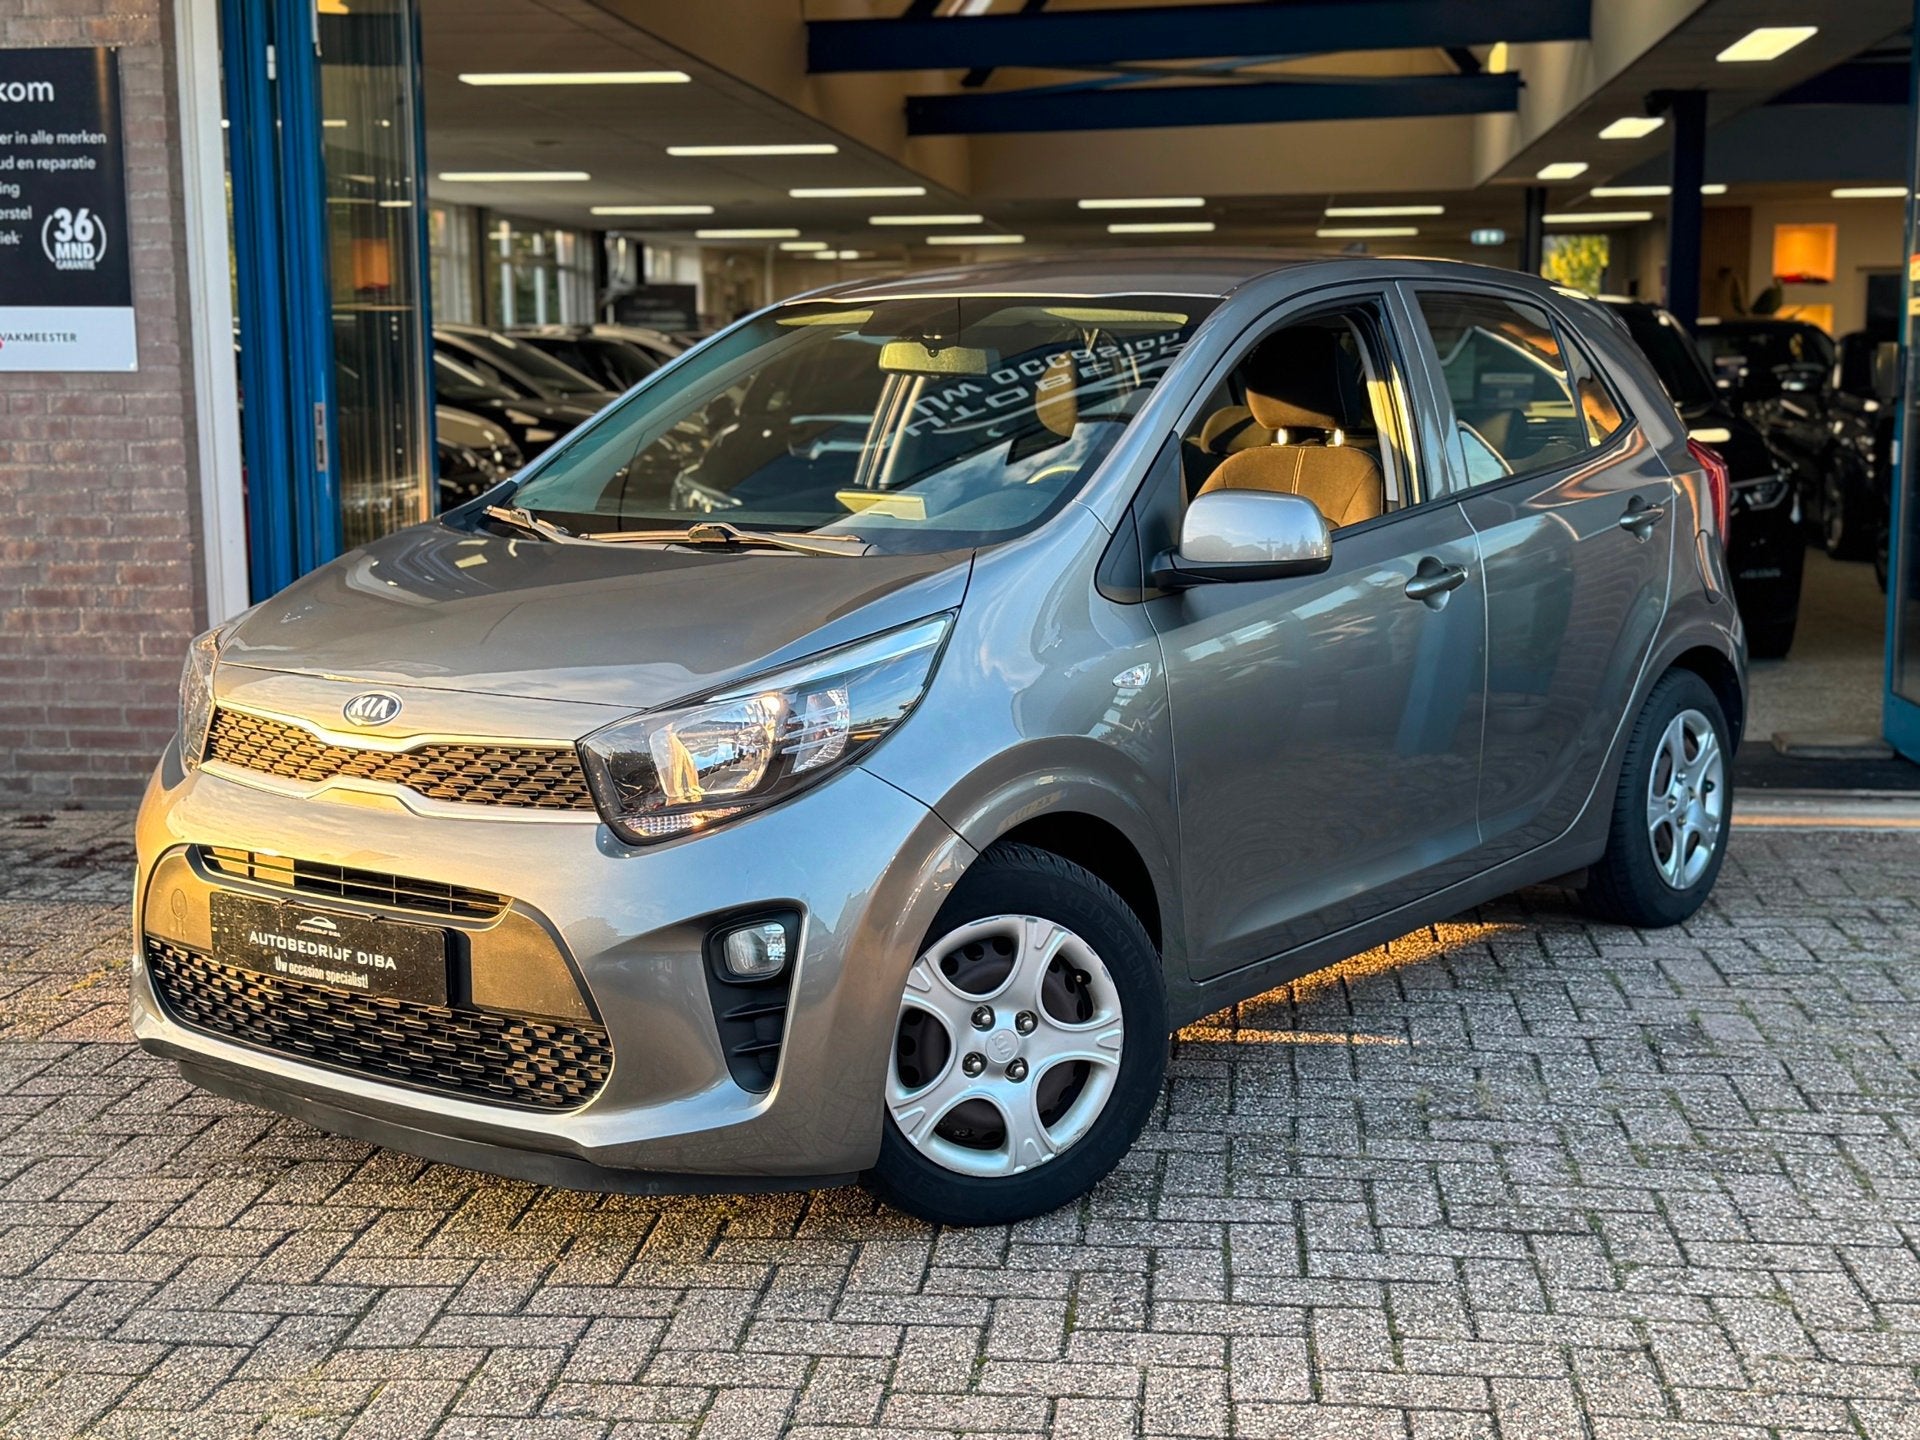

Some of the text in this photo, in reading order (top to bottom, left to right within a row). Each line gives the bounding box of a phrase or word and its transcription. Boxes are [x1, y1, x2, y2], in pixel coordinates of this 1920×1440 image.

[15, 131, 28, 144] in
[31, 130, 54, 144] alle
[57, 130, 107, 143] merken
[17, 159, 34, 170] en
[37, 155, 96, 173] reparatie
[54, 207, 94, 242] 36
[55, 242, 95, 260] MND
[350, 696, 390, 719] KIA
[249, 930, 352, 962] AUTOBEDRIJF
[357, 951, 397, 971] DIBA
[275, 955, 369, 989] Uw occasion specialist!
